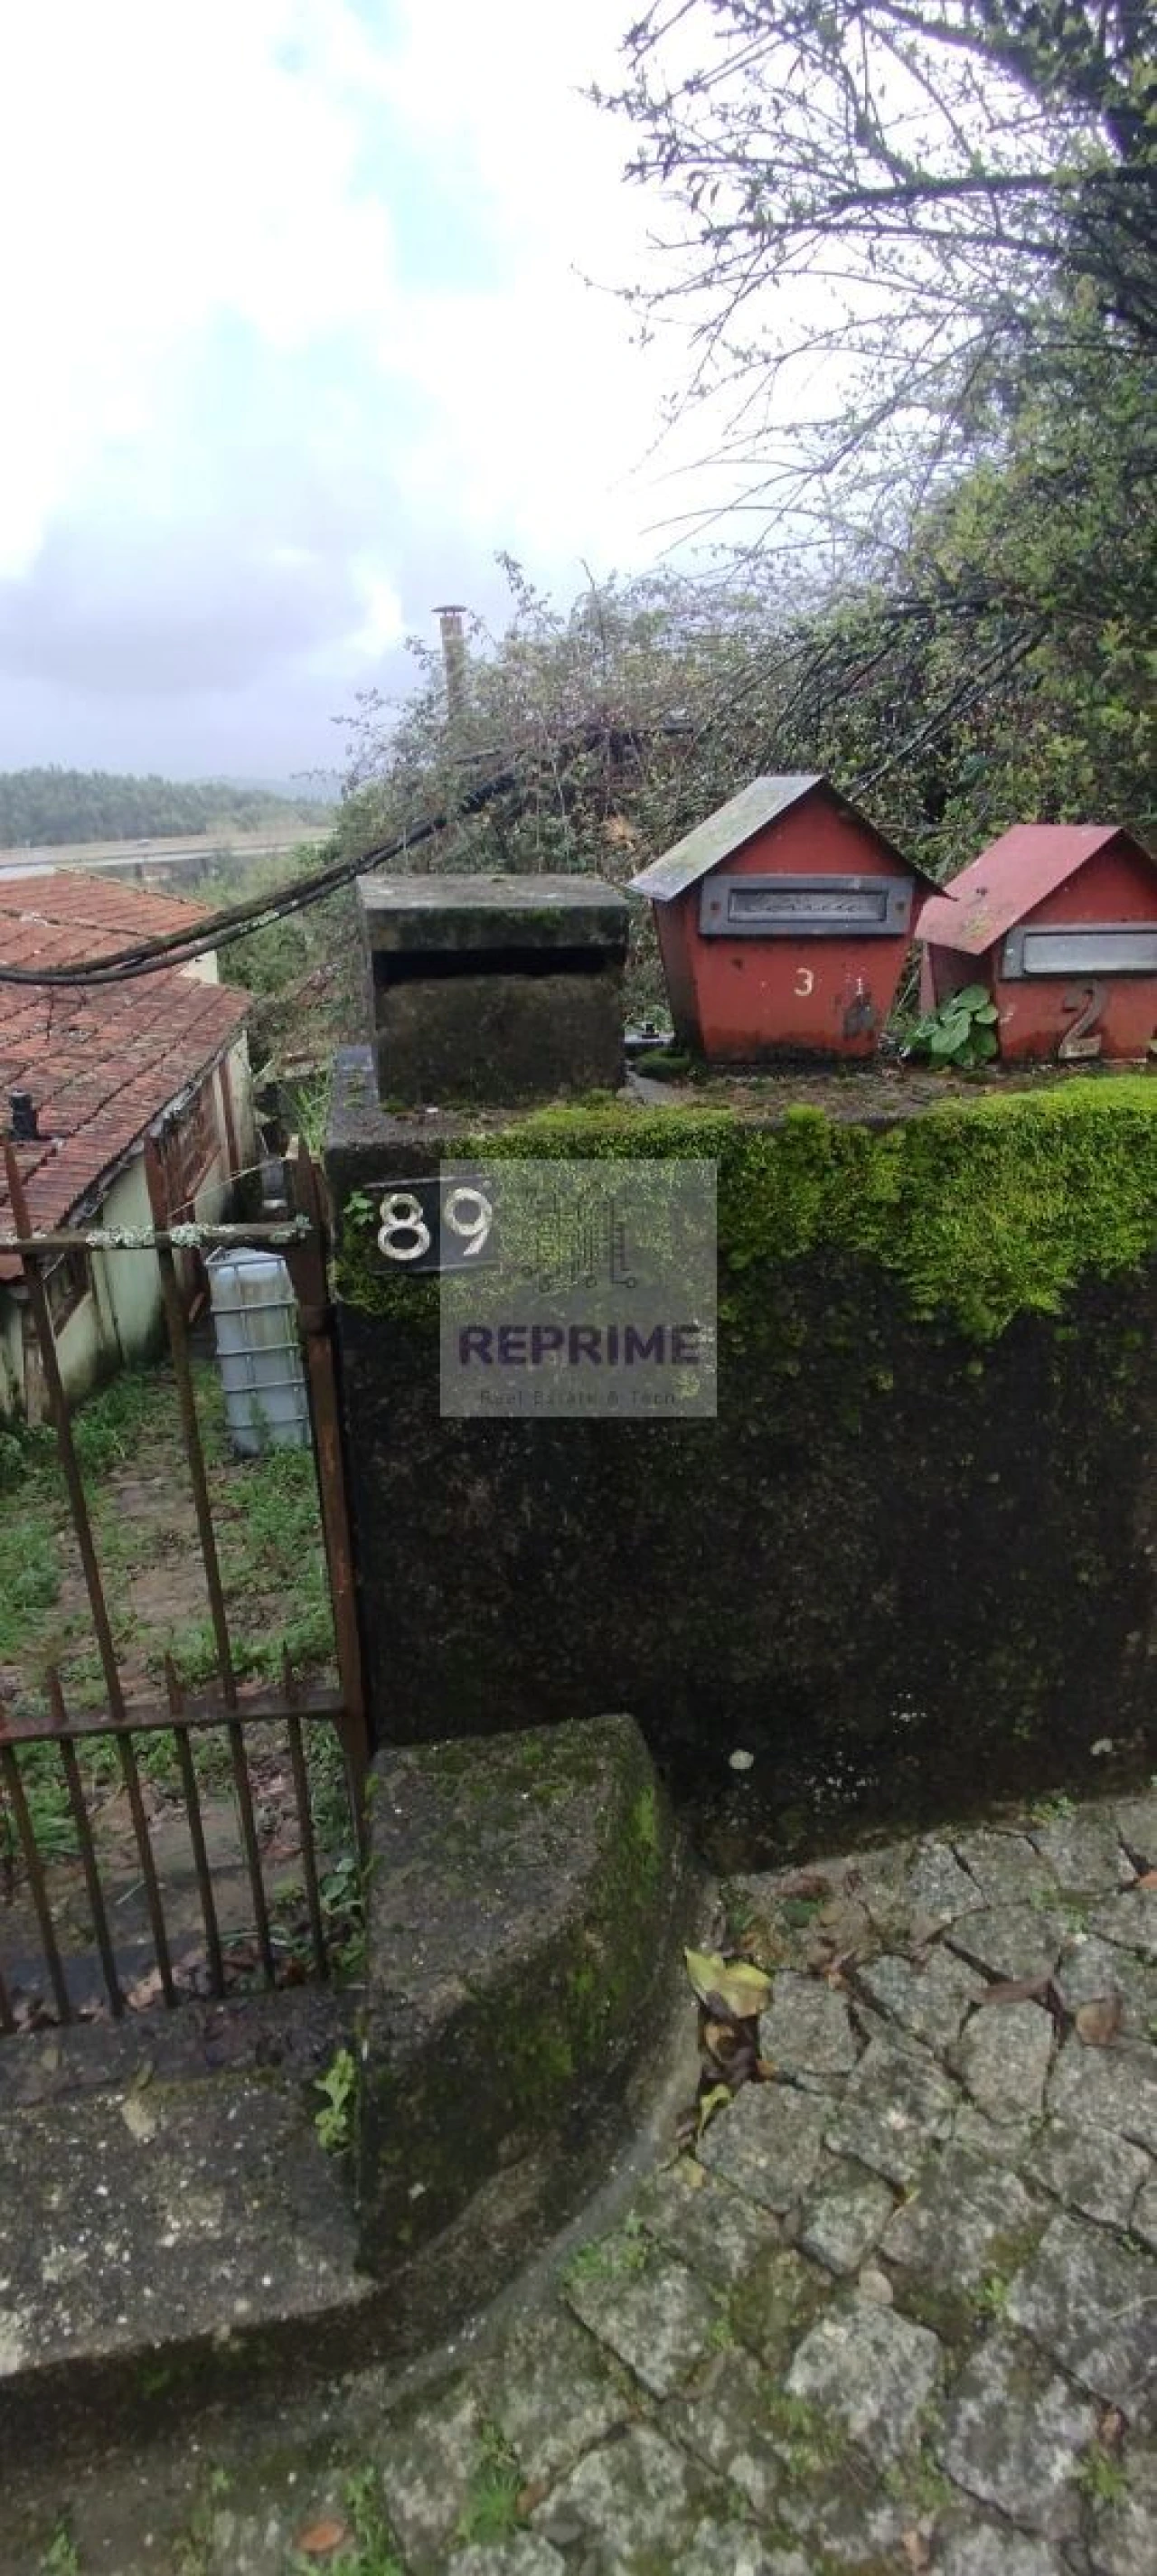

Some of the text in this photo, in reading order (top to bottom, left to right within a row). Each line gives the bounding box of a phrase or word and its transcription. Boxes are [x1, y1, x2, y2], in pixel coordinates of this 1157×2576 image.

[794, 967, 814, 996] 3
[1058, 979, 1106, 1059] 2
[378, 1187, 494, 1260] 89
